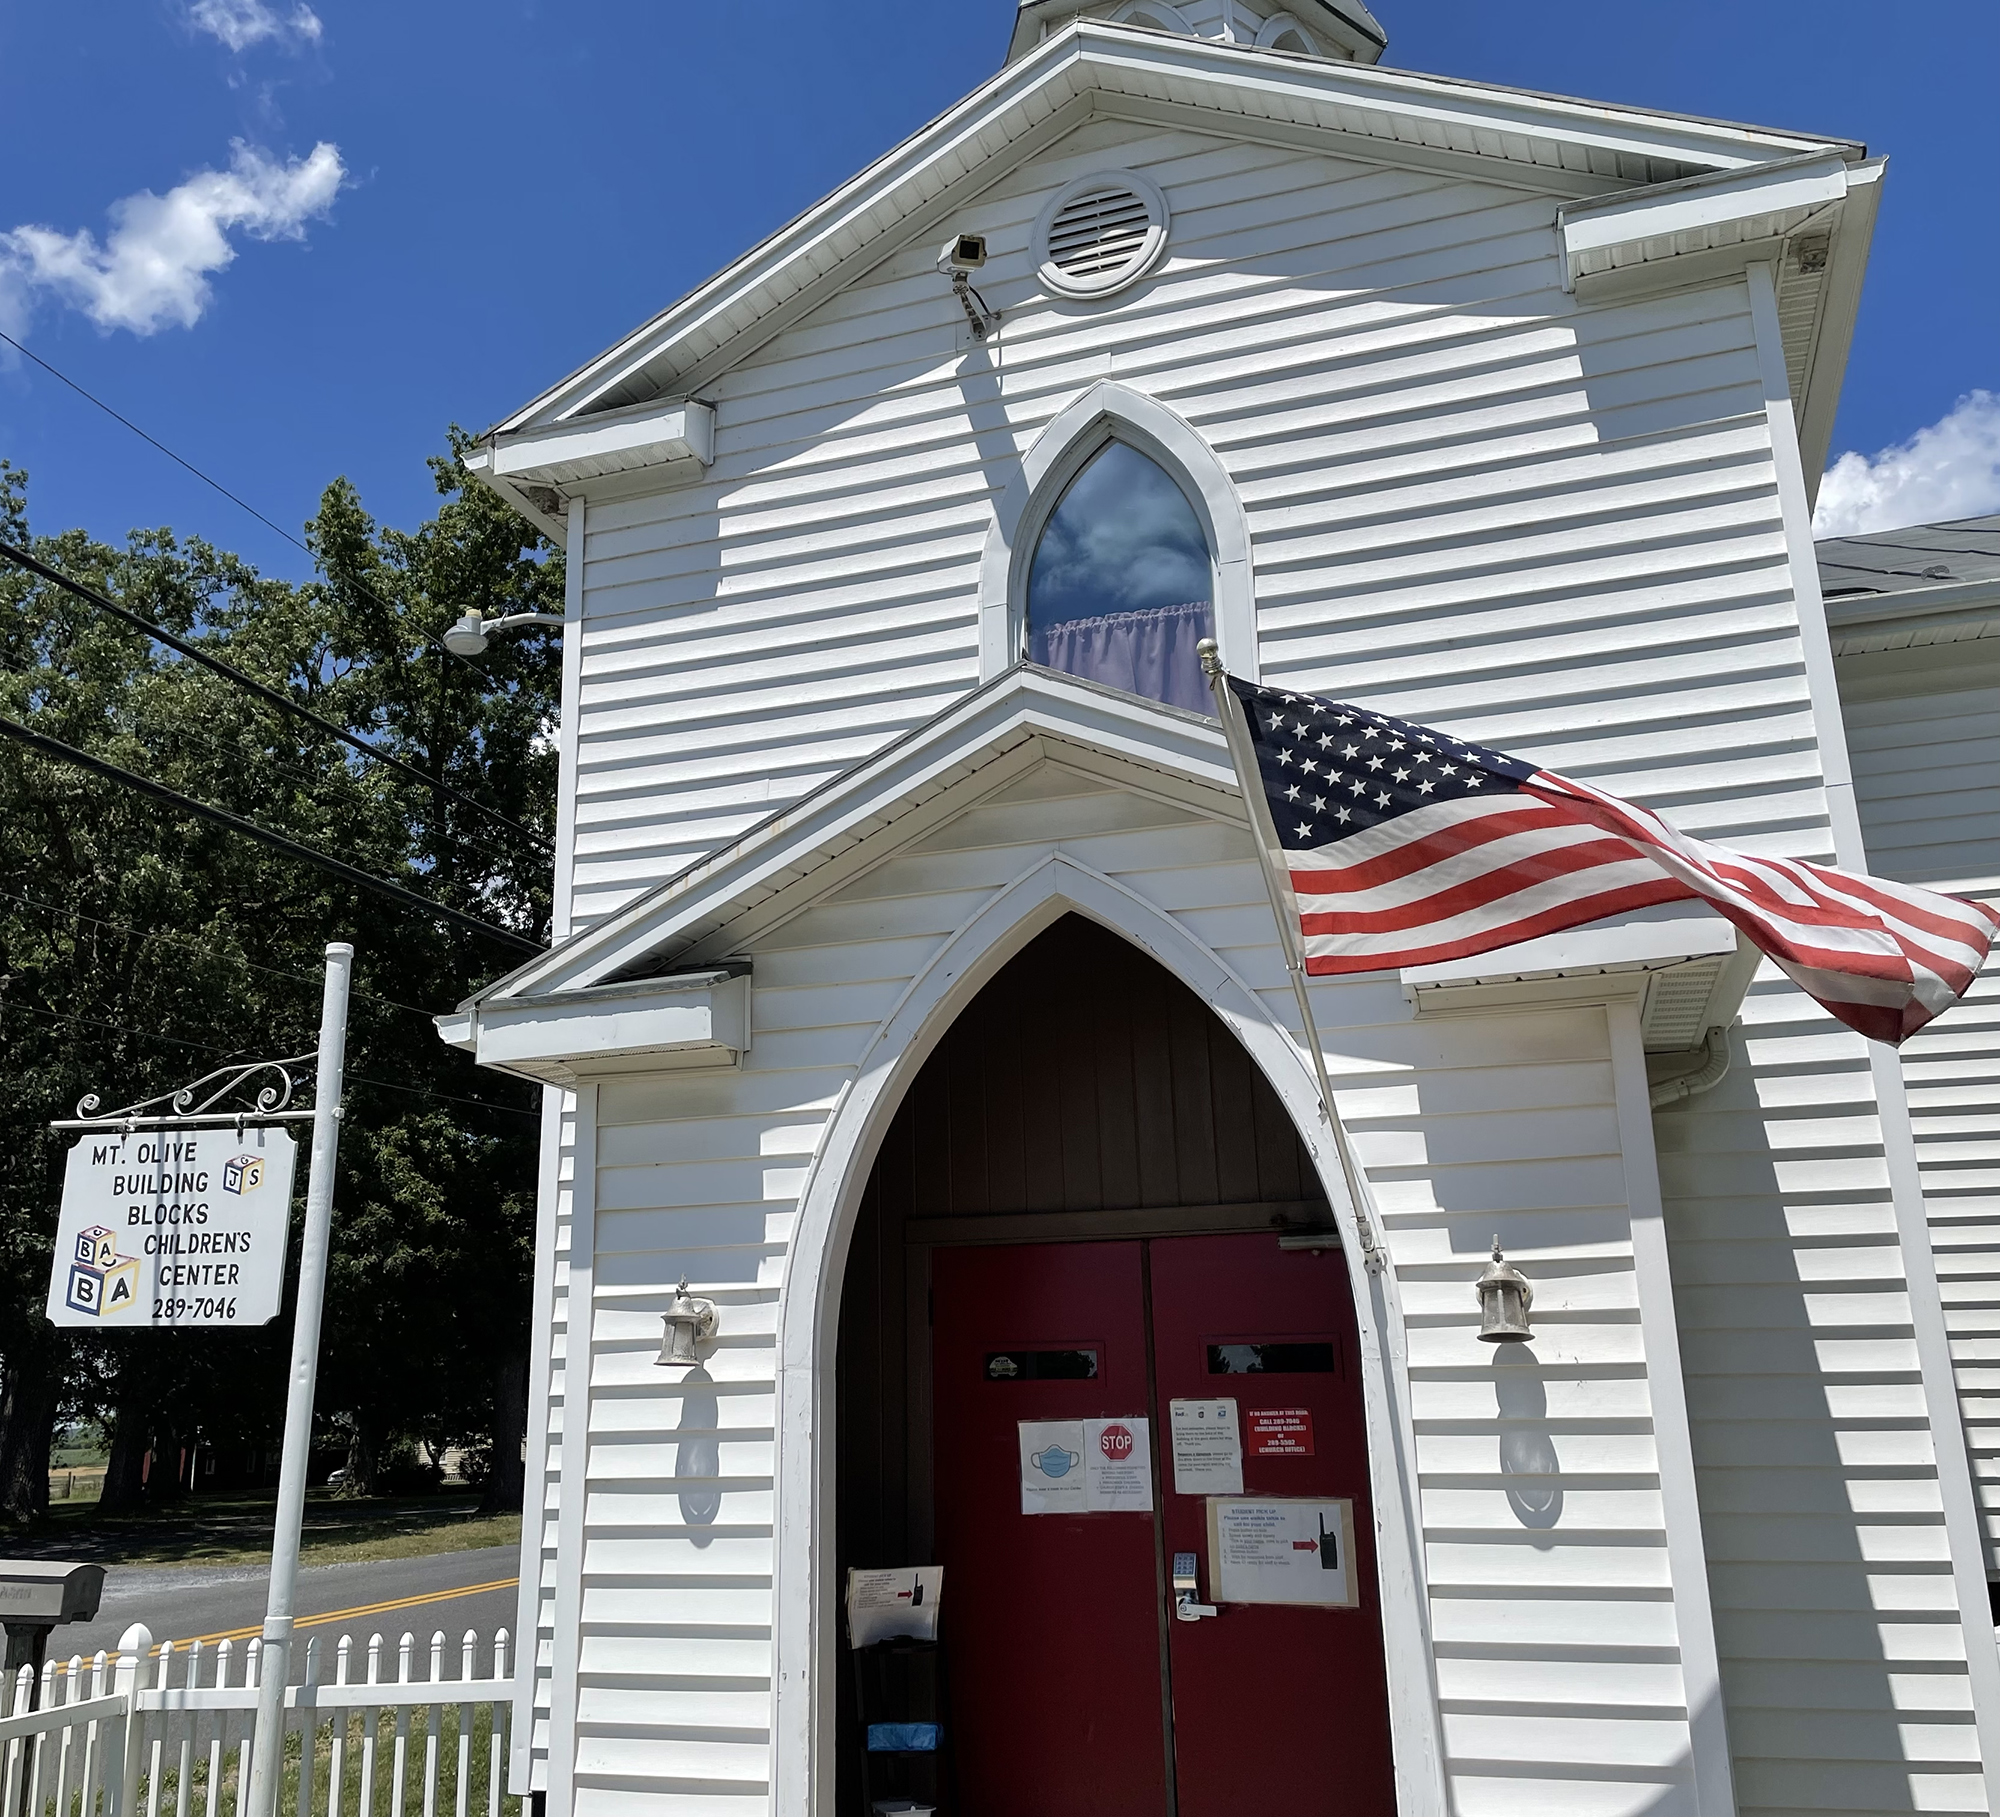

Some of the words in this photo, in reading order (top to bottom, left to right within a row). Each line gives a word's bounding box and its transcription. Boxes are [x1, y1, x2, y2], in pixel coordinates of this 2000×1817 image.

[92, 1145, 126, 1166] MT.
[137, 1142, 198, 1164] OLIVE
[240, 1156, 249, 1165] G
[113, 1172, 209, 1196] BUILDING
[229, 1169, 239, 1187] J
[249, 1168, 260, 1186] S
[127, 1203, 209, 1226] BLOCKS
[93, 1229, 102, 1237] C
[144, 1231, 251, 1255] CHILDREN'S
[80, 1241, 90, 1257] B
[99, 1242, 111, 1259] A
[159, 1263, 239, 1287] CENTER
[77, 1277, 94, 1303] B
[110, 1276, 130, 1303] A
[152, 1296, 237, 1319] 289-7046
[1102, 1435, 1132, 1450] STOP
